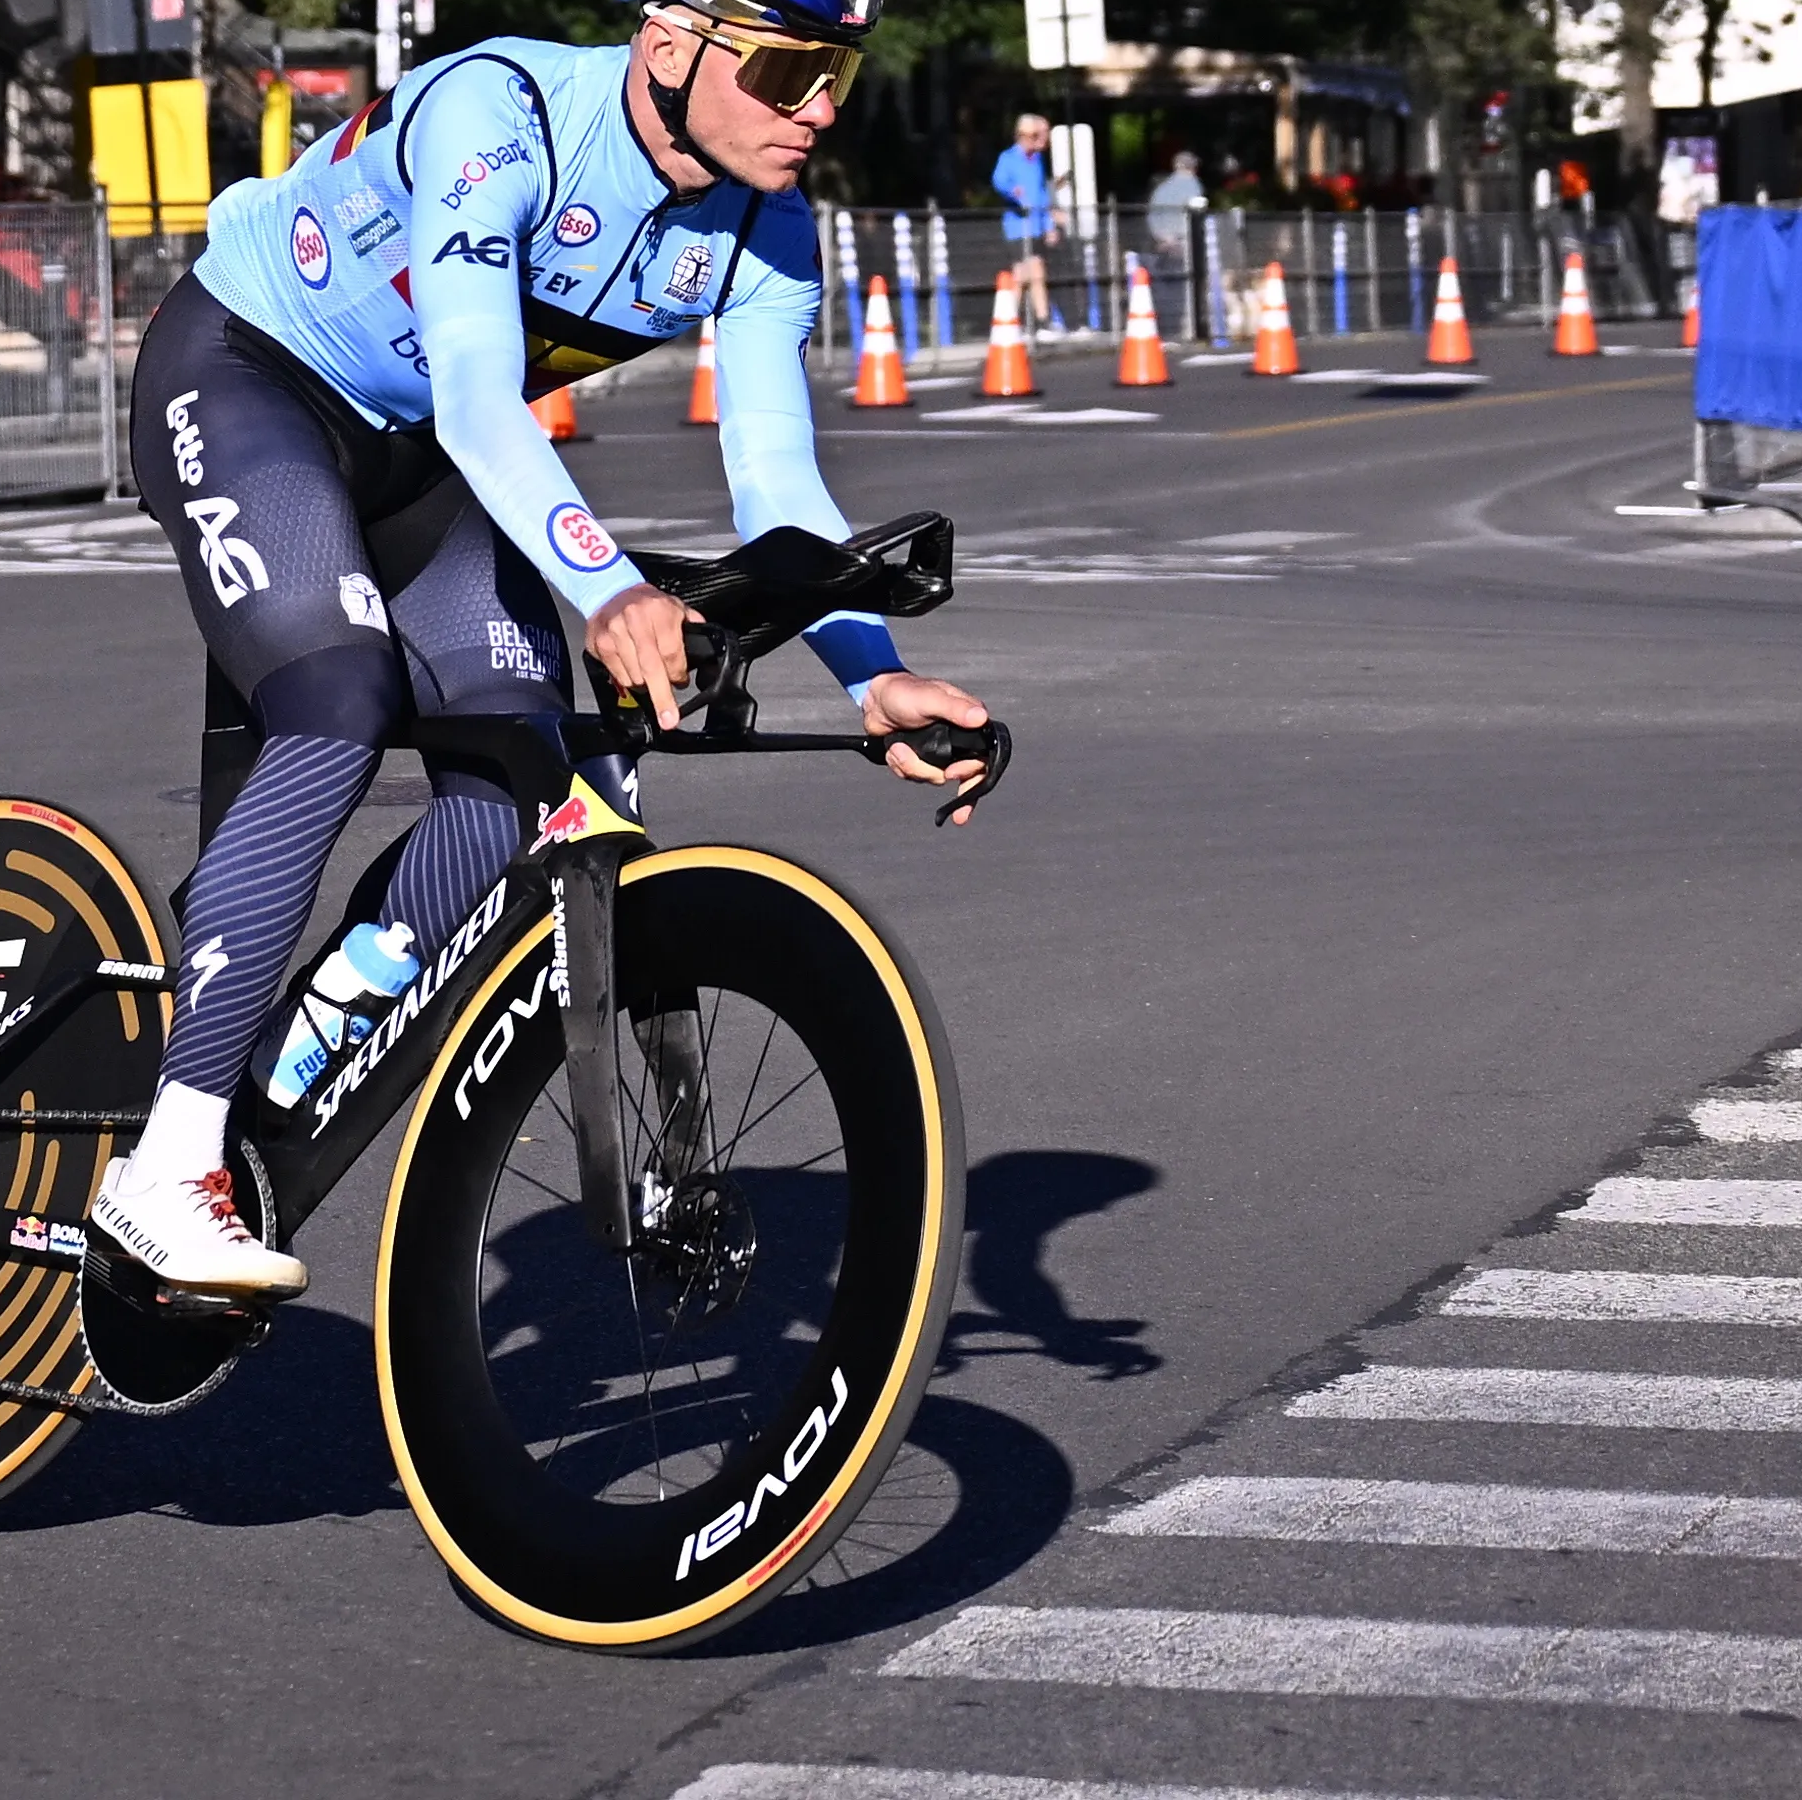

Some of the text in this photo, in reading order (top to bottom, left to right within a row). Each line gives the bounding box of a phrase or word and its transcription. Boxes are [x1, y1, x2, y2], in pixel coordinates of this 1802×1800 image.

[544, 272, 583, 296] EY
[487, 620, 560, 660] BELGIAN
[491, 646, 560, 680] CYCLING
[551, 876, 571, 1008] S-WORKS
[97, 960, 165, 981] SRAM
[312, 877, 507, 1139] SPECIALIZED
[675, 1367, 850, 1580] roval
